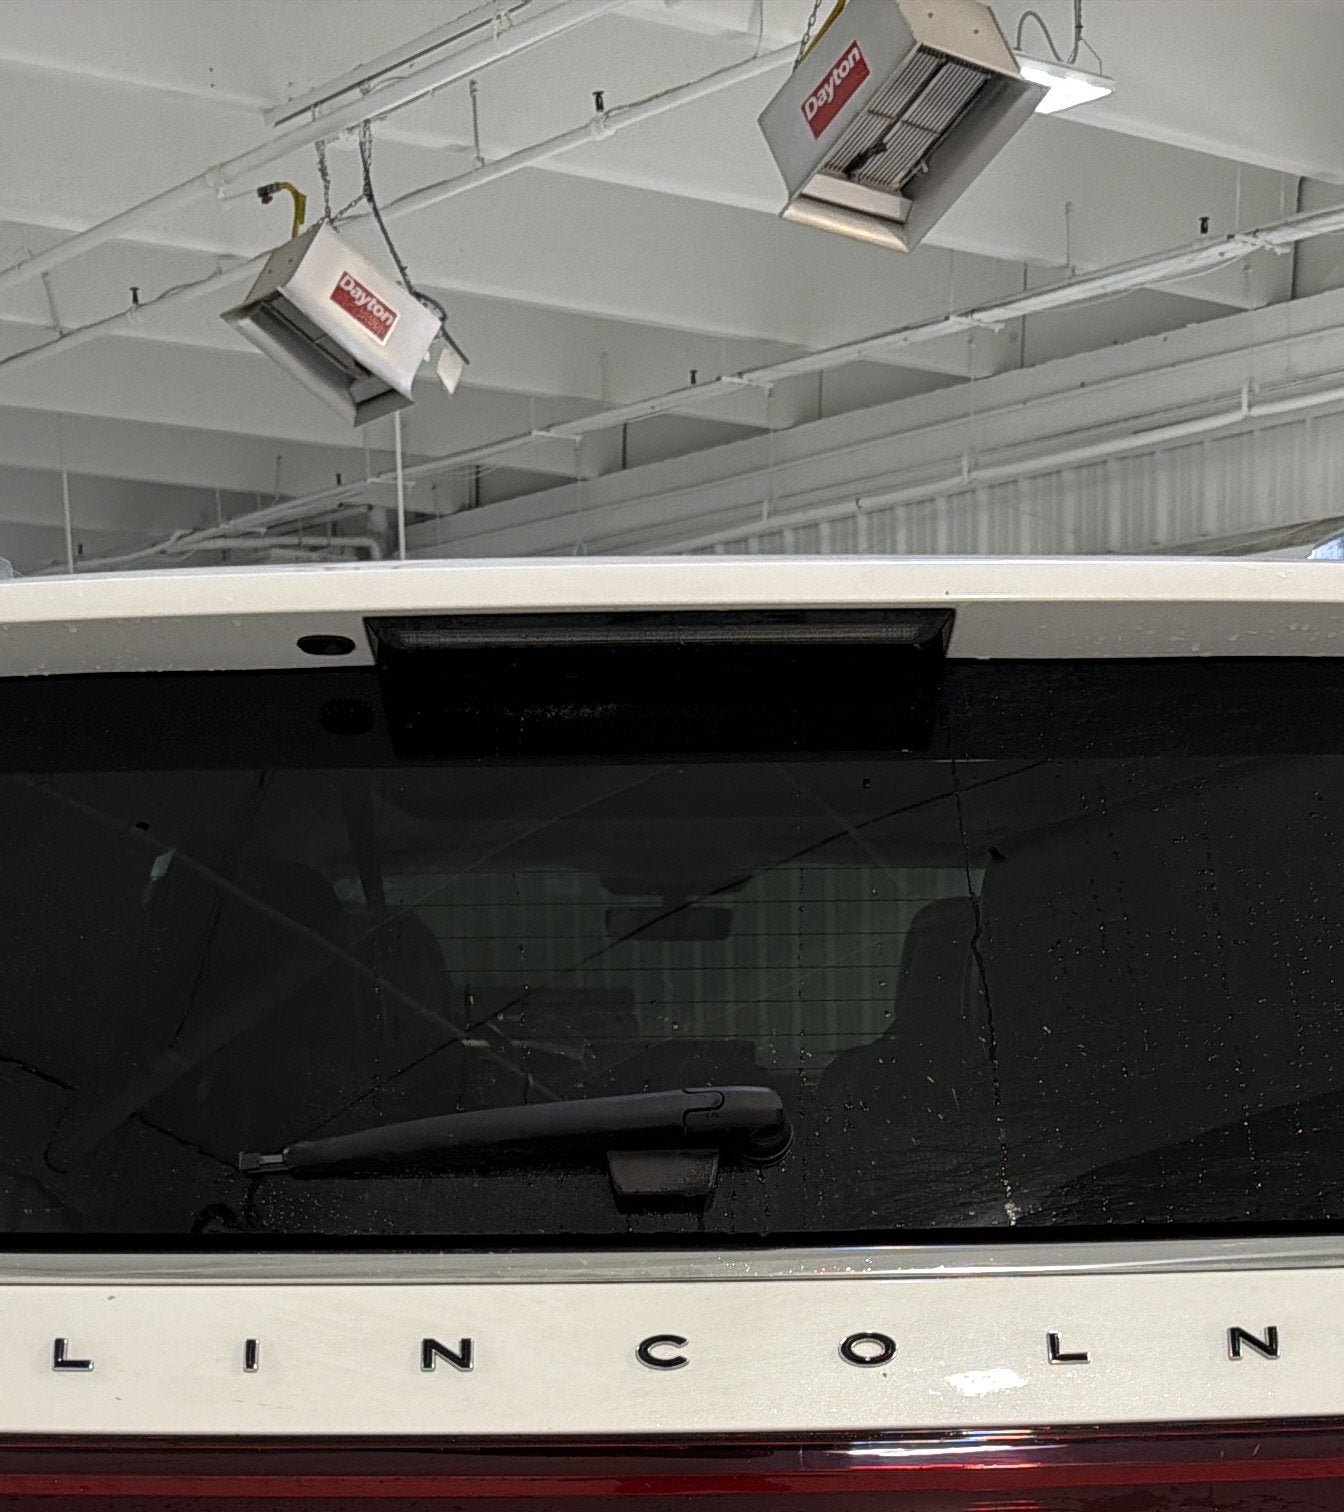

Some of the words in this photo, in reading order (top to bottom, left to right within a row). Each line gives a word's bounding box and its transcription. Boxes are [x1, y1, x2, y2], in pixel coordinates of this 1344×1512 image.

[804, 47, 861, 121] Dayton
[338, 274, 395, 326] Dayton
[51, 1326, 1281, 1372] LINCOLN
